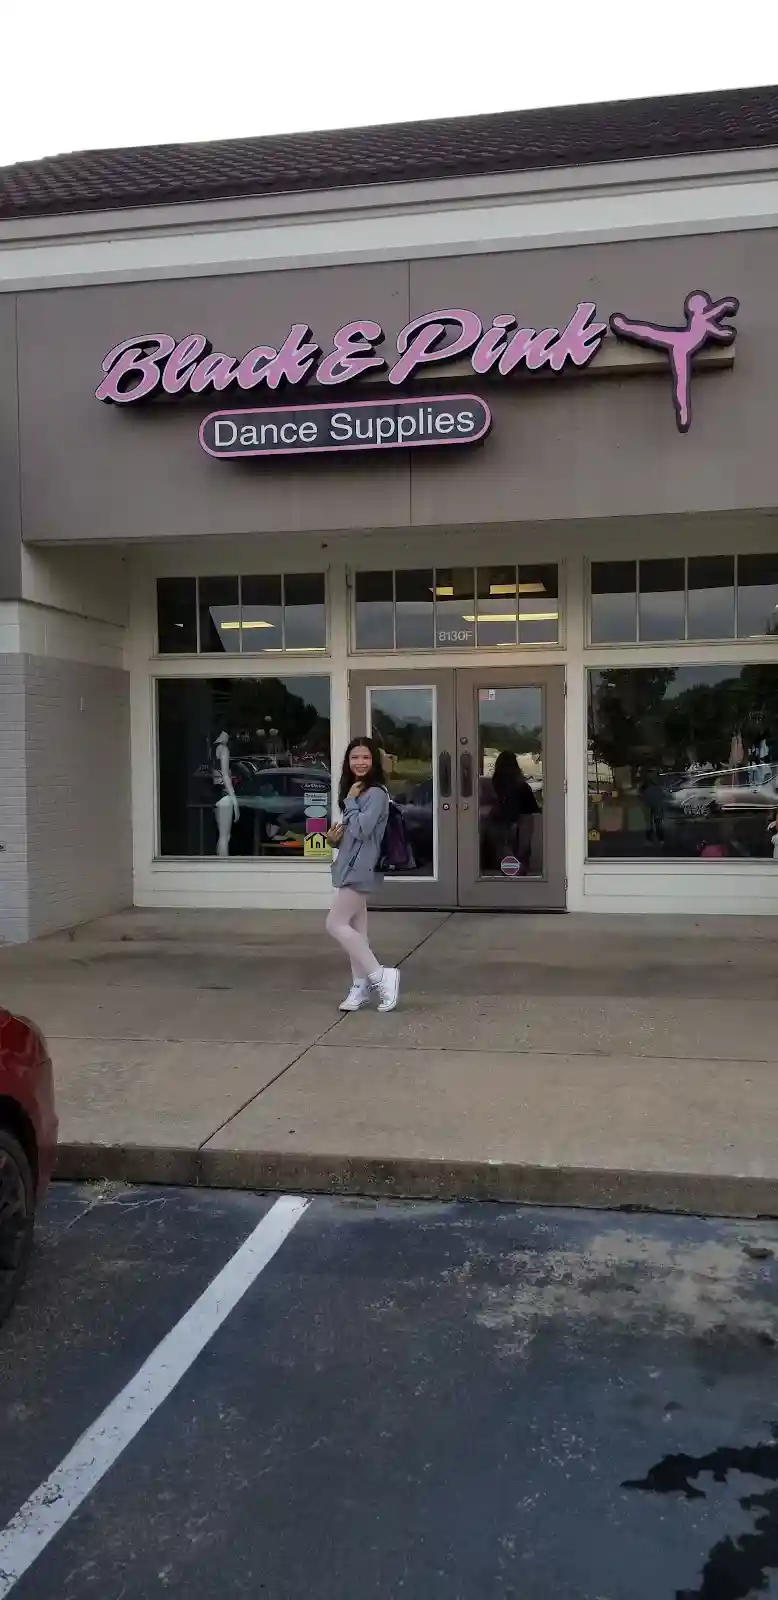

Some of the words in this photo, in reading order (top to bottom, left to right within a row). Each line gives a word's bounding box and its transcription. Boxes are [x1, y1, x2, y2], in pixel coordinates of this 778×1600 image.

[94, 323, 318, 403] Black
[315, 320, 384, 386] &
[388, 301, 607, 386] Pink
[213, 418, 319, 448] Dance
[329, 407, 476, 445] Supplies
[438, 630, 473, 642] 8130F
